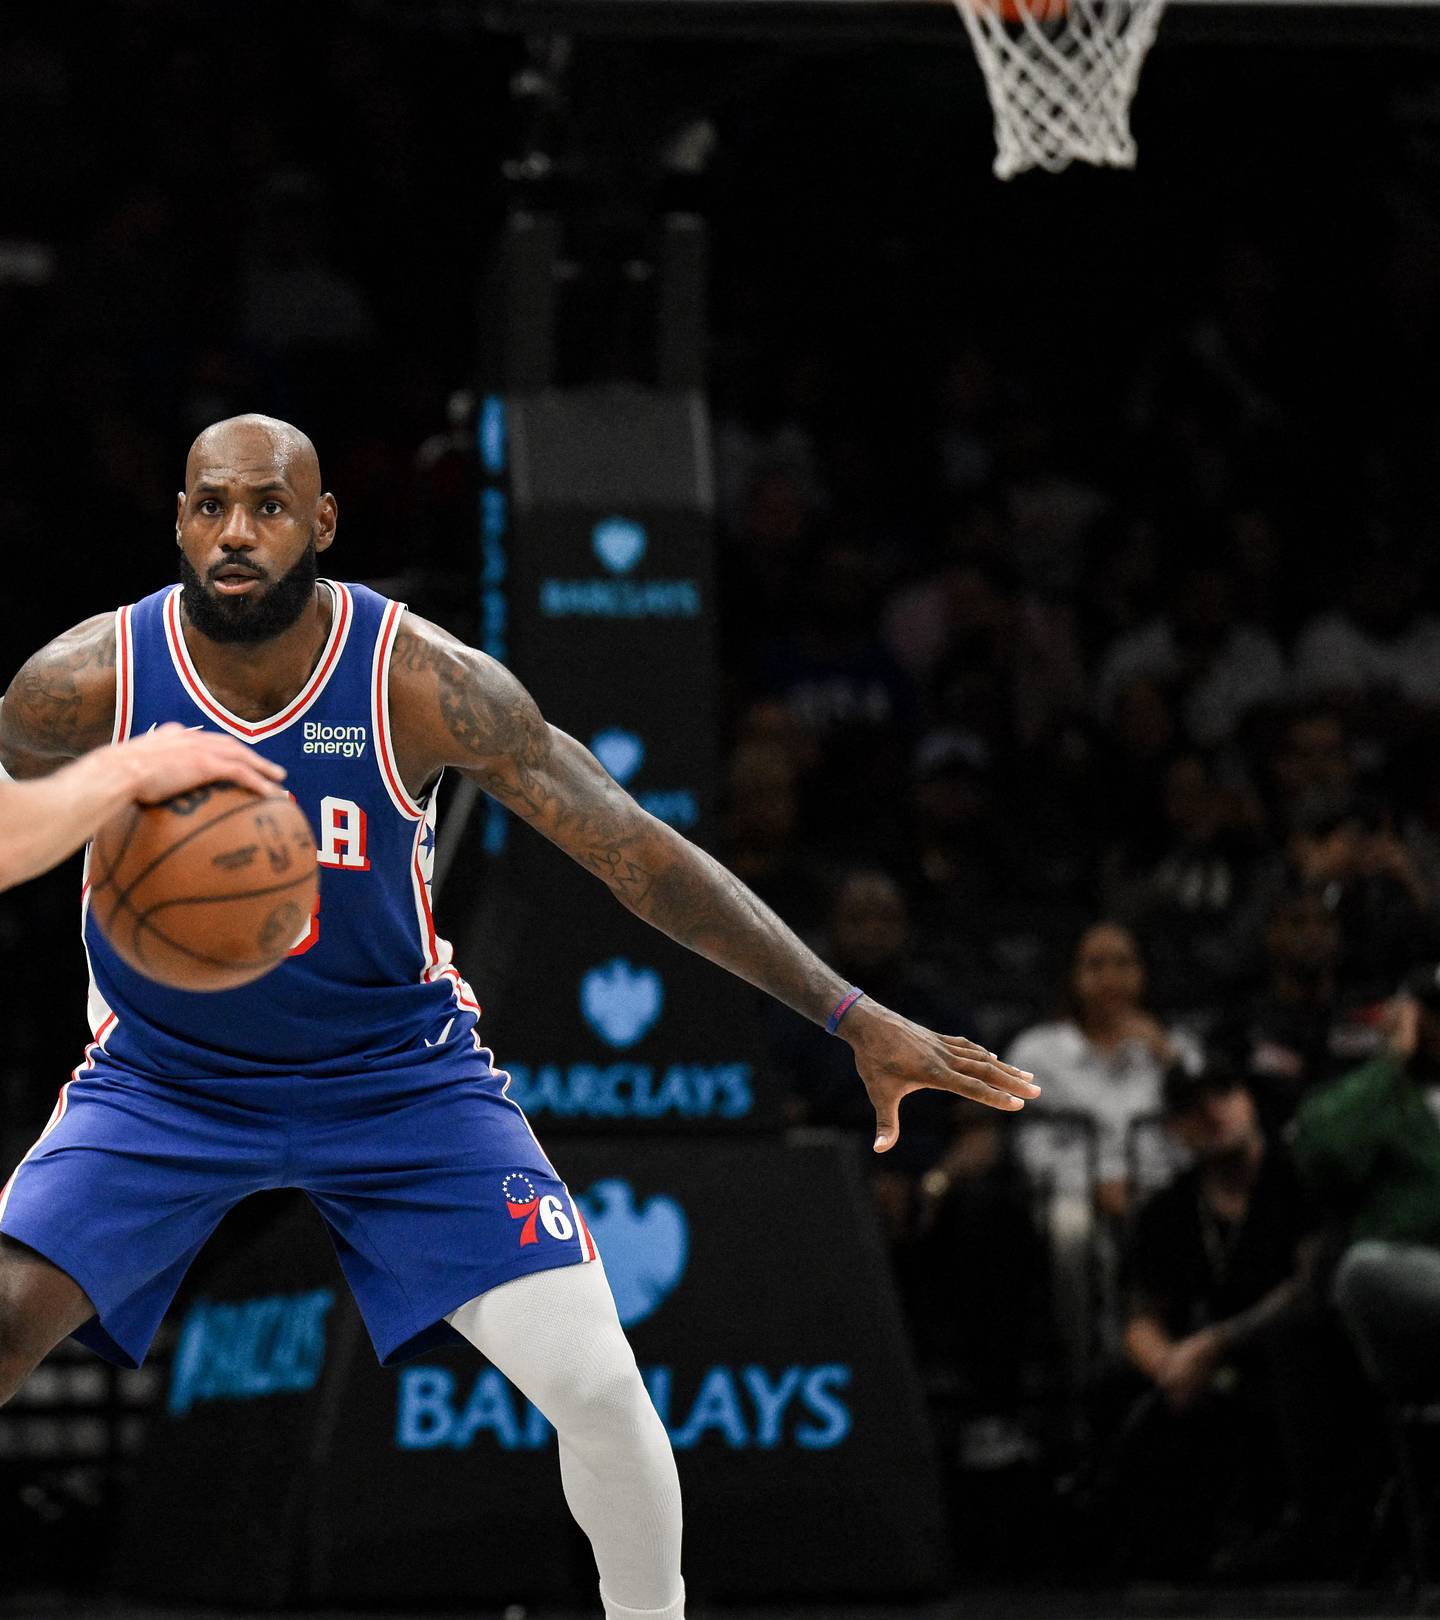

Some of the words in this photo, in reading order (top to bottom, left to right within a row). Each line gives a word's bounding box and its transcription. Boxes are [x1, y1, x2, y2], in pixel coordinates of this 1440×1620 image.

[303, 722, 366, 740] Bloom
[303, 741, 366, 758] energy
[506, 1195, 574, 1248] 76
